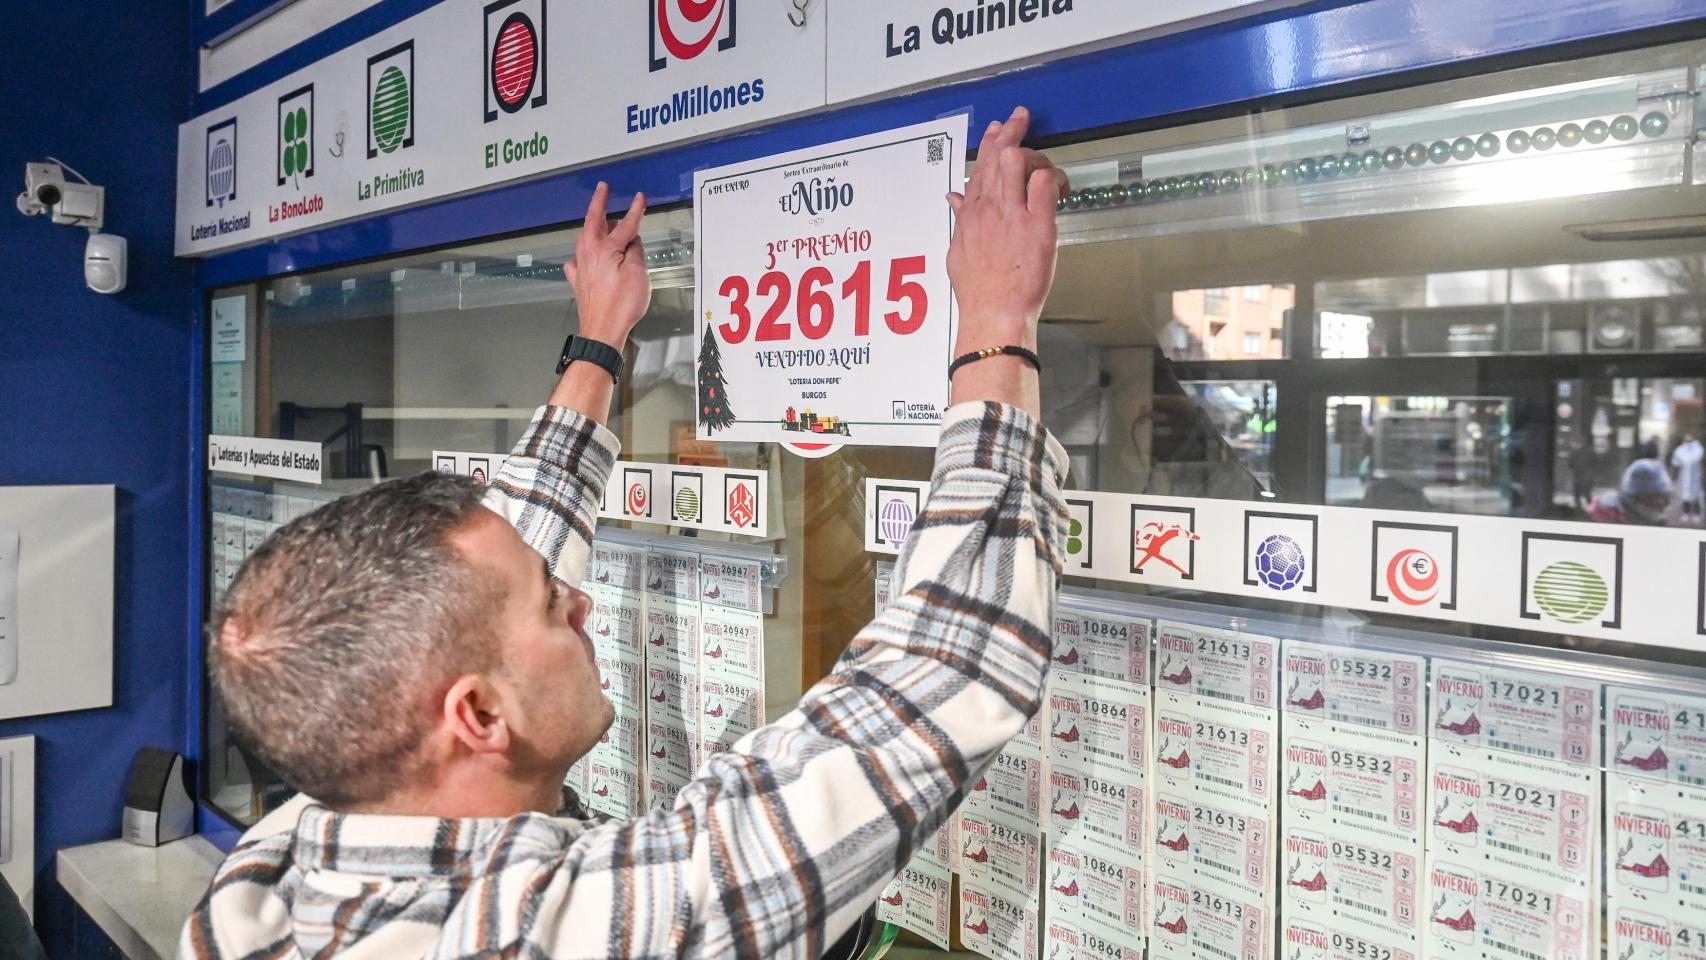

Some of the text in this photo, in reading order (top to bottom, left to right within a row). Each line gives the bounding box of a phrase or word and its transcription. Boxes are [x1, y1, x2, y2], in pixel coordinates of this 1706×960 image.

[886, 23, 921, 58] La
[627, 78, 765, 133] EuroMillones
[485, 131, 549, 169] El Gordo
[784, 159, 849, 179] Sorteo Extraordinario de
[358, 168, 425, 201] La Primitiva
[708, 179, 750, 196] 6 DE ENERO
[779, 176, 854, 216] El Niño
[269, 195, 324, 223] La BonoLoto
[191, 211, 251, 241] Lotería Nacional
[791, 227, 872, 261] PREMIO
[718, 255, 929, 345] 32615
[755, 342, 871, 370] VENDIDO AQUÍ
[812, 377, 825, 386] DON
[801, 391, 827, 400] BURGOS
[907, 411, 943, 421] NACIONAL
[218, 446, 320, 472] Loterías y Apuestas del Estado
[663, 558, 687, 569] 06278
[721, 565, 747, 577] 26947
[723, 624, 749, 637] 26947
[1084, 621, 1127, 638] 10864
[1160, 637, 1194, 654] INVIERNO
[1198, 638, 1250, 659] 21613
[1134, 668, 1141, 676] 15
[1286, 658, 1325, 676] INVIERNO
[1330, 659, 1391, 679] 05532
[667, 671, 687, 684] 06278
[724, 684, 750, 698] 26947
[1257, 690, 1265, 699] 15
[1437, 678, 1483, 699] INVIERNO
[1490, 681, 1560, 705] 17021
[1050, 697, 1080, 714] INVIERNO
[1083, 700, 1127, 719] 10864
[1401, 714, 1410, 723] 15
[1613, 708, 1670, 731] INVIERNO
[667, 728, 688, 741] 06278
[1158, 719, 1192, 739] INVIERNO
[1196, 723, 1248, 745] 21613
[1133, 750, 1140, 758] 15
[1287, 748, 1327, 767] INVIERNO
[1571, 745, 1582, 755] 15
[997, 753, 1027, 770] 8745
[1331, 751, 1391, 774] 05532
[1051, 774, 1080, 792] INVIERNO
[1083, 778, 1126, 799] 10864
[1255, 778, 1262, 787] 15
[1434, 775, 1480, 798] INVIERNO
[1487, 781, 1556, 808] 17021
[1156, 802, 1191, 822] INVIERNO
[1194, 807, 1245, 832] 21613
[1401, 810, 1410, 819] 15
[962, 820, 988, 837] INVIERNO
[991, 823, 1026, 845] 28745
[1131, 831, 1138, 840] 15
[1614, 815, 1671, 839] INVIERNO
[1287, 838, 1328, 859] INVIERNO
[1332, 842, 1392, 869] 05532
[1567, 850, 1578, 860] 15
[1050, 850, 1080, 869] INVIERNO
[1083, 855, 1123, 880] 10864
[905, 869, 936, 890] 23576
[1251, 866, 1258, 875] 15
[1154, 883, 1189, 905] INVIERNO
[1431, 872, 1478, 896] INVIERNO
[963, 891, 989, 909] INVIERNO
[1193, 891, 1242, 919] 21613
[1484, 880, 1551, 911] 17021
[991, 897, 1024, 920] 28745
[1129, 912, 1136, 921] 15
[1400, 906, 1409, 916] 15
[1050, 926, 1079, 946] INVIERNO
[1287, 928, 1328, 950] INVIERNO
[1616, 920, 1672, 947] INVIERNO
[1082, 933, 1122, 959] 10864
[1332, 934, 1391, 960] 05532
